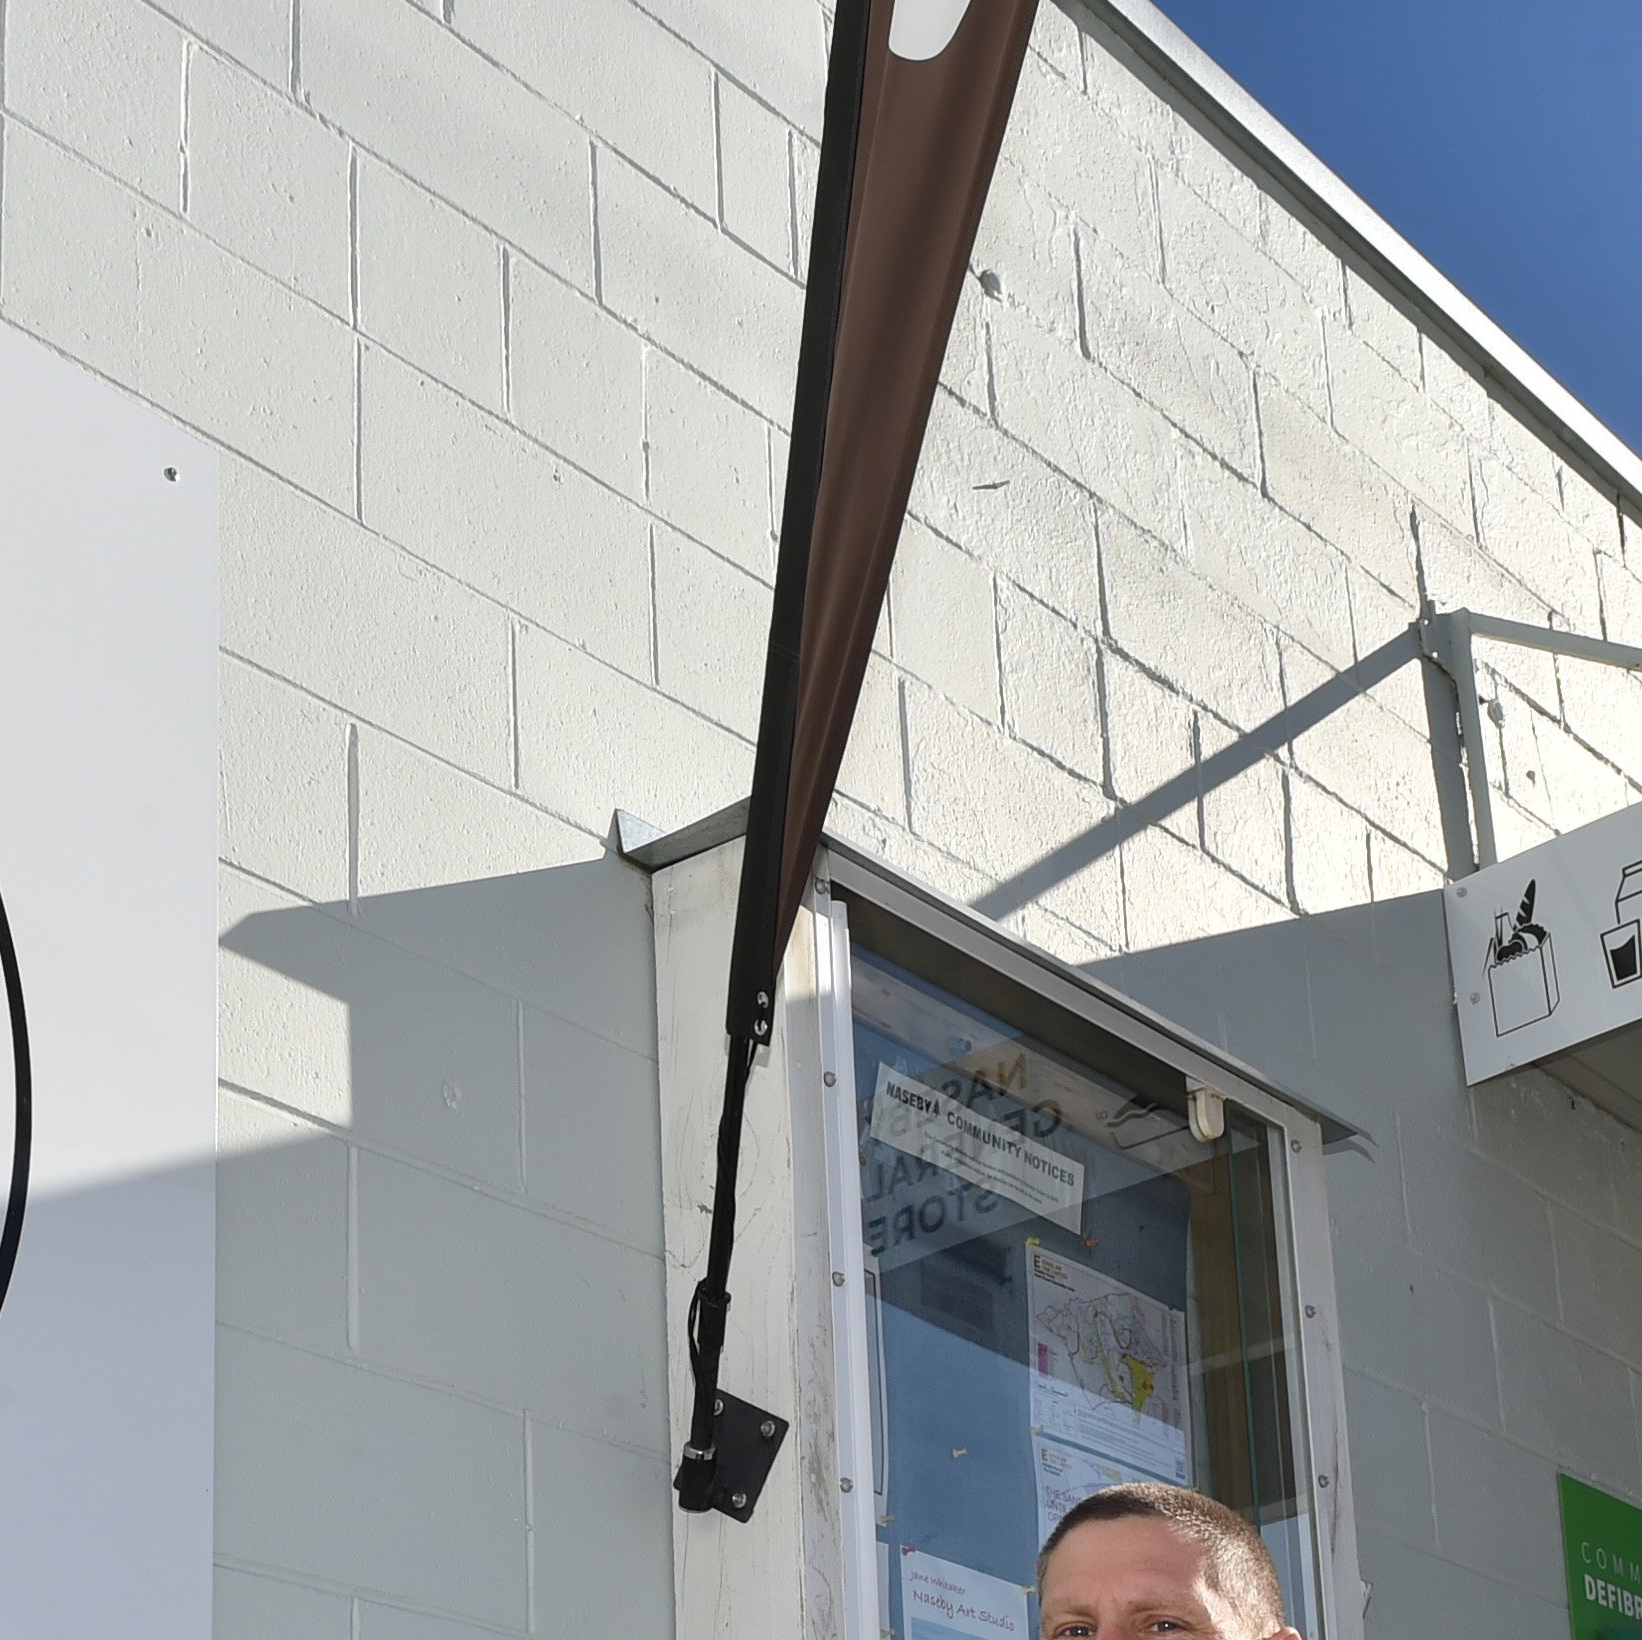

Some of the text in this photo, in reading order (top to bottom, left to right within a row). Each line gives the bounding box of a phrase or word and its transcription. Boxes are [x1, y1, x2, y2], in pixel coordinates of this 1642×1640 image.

[886, 1081, 932, 1115] NASEBY
[947, 1111, 1023, 1161] COMMUNITY
[1024, 1149, 1075, 1187] NOTICES
[913, 1590, 1015, 1632] Naseby Art Studio
